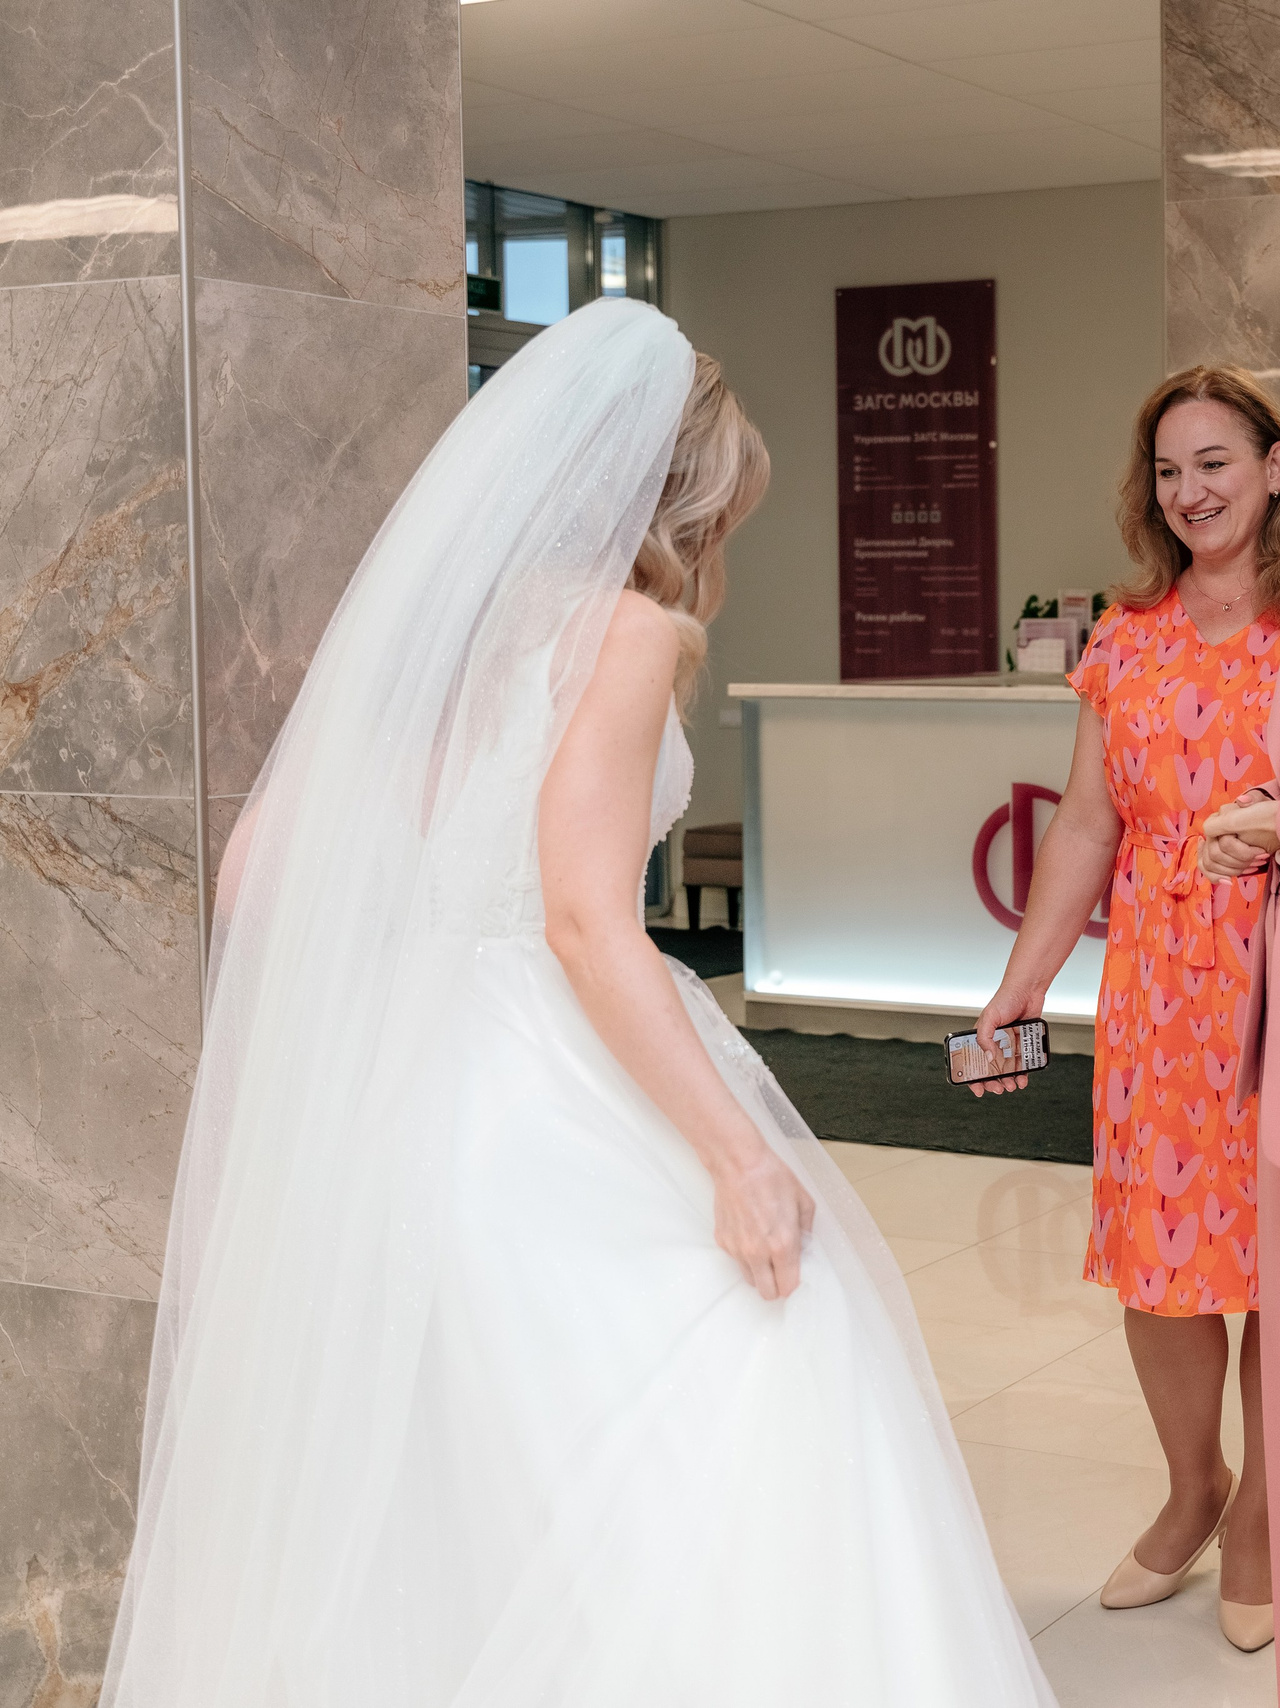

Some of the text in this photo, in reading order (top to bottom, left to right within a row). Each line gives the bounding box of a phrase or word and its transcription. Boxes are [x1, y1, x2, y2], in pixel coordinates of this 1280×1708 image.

[853, 390, 980, 411] ЗАГС МОСКВЫ
[853, 431, 979, 446] Управление ЗАГС Москвы
[854, 611, 926, 624] Режим работы
